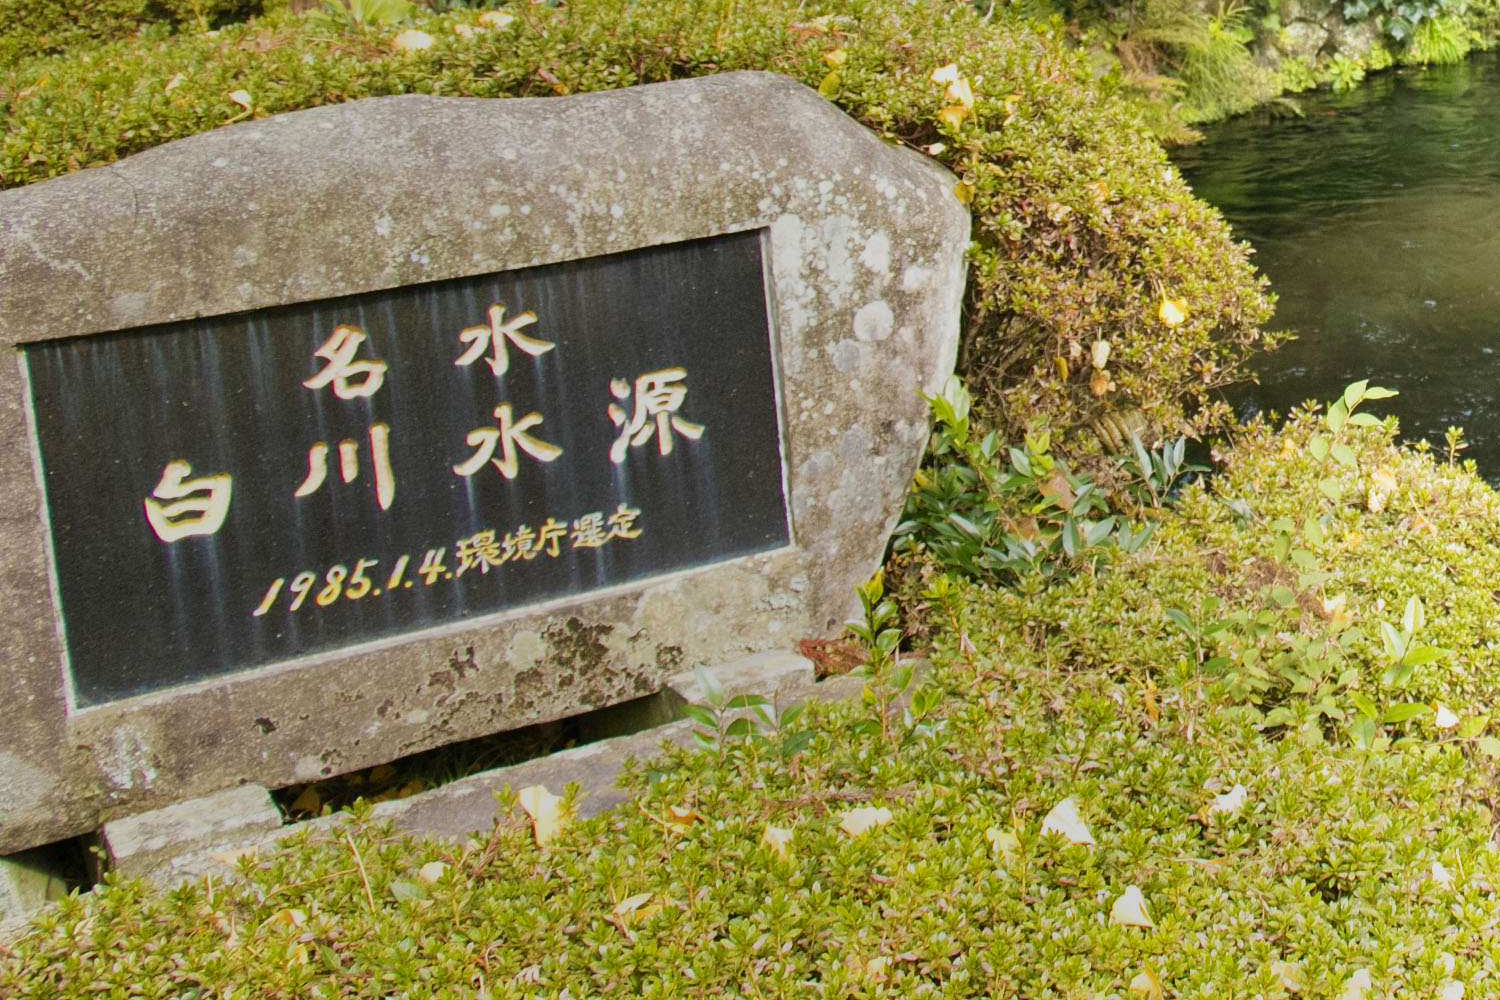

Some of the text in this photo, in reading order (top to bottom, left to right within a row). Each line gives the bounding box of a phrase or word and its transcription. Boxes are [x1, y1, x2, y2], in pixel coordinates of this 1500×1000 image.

[303, 303, 556, 400] 名水
[145, 367, 704, 543] 白川水源
